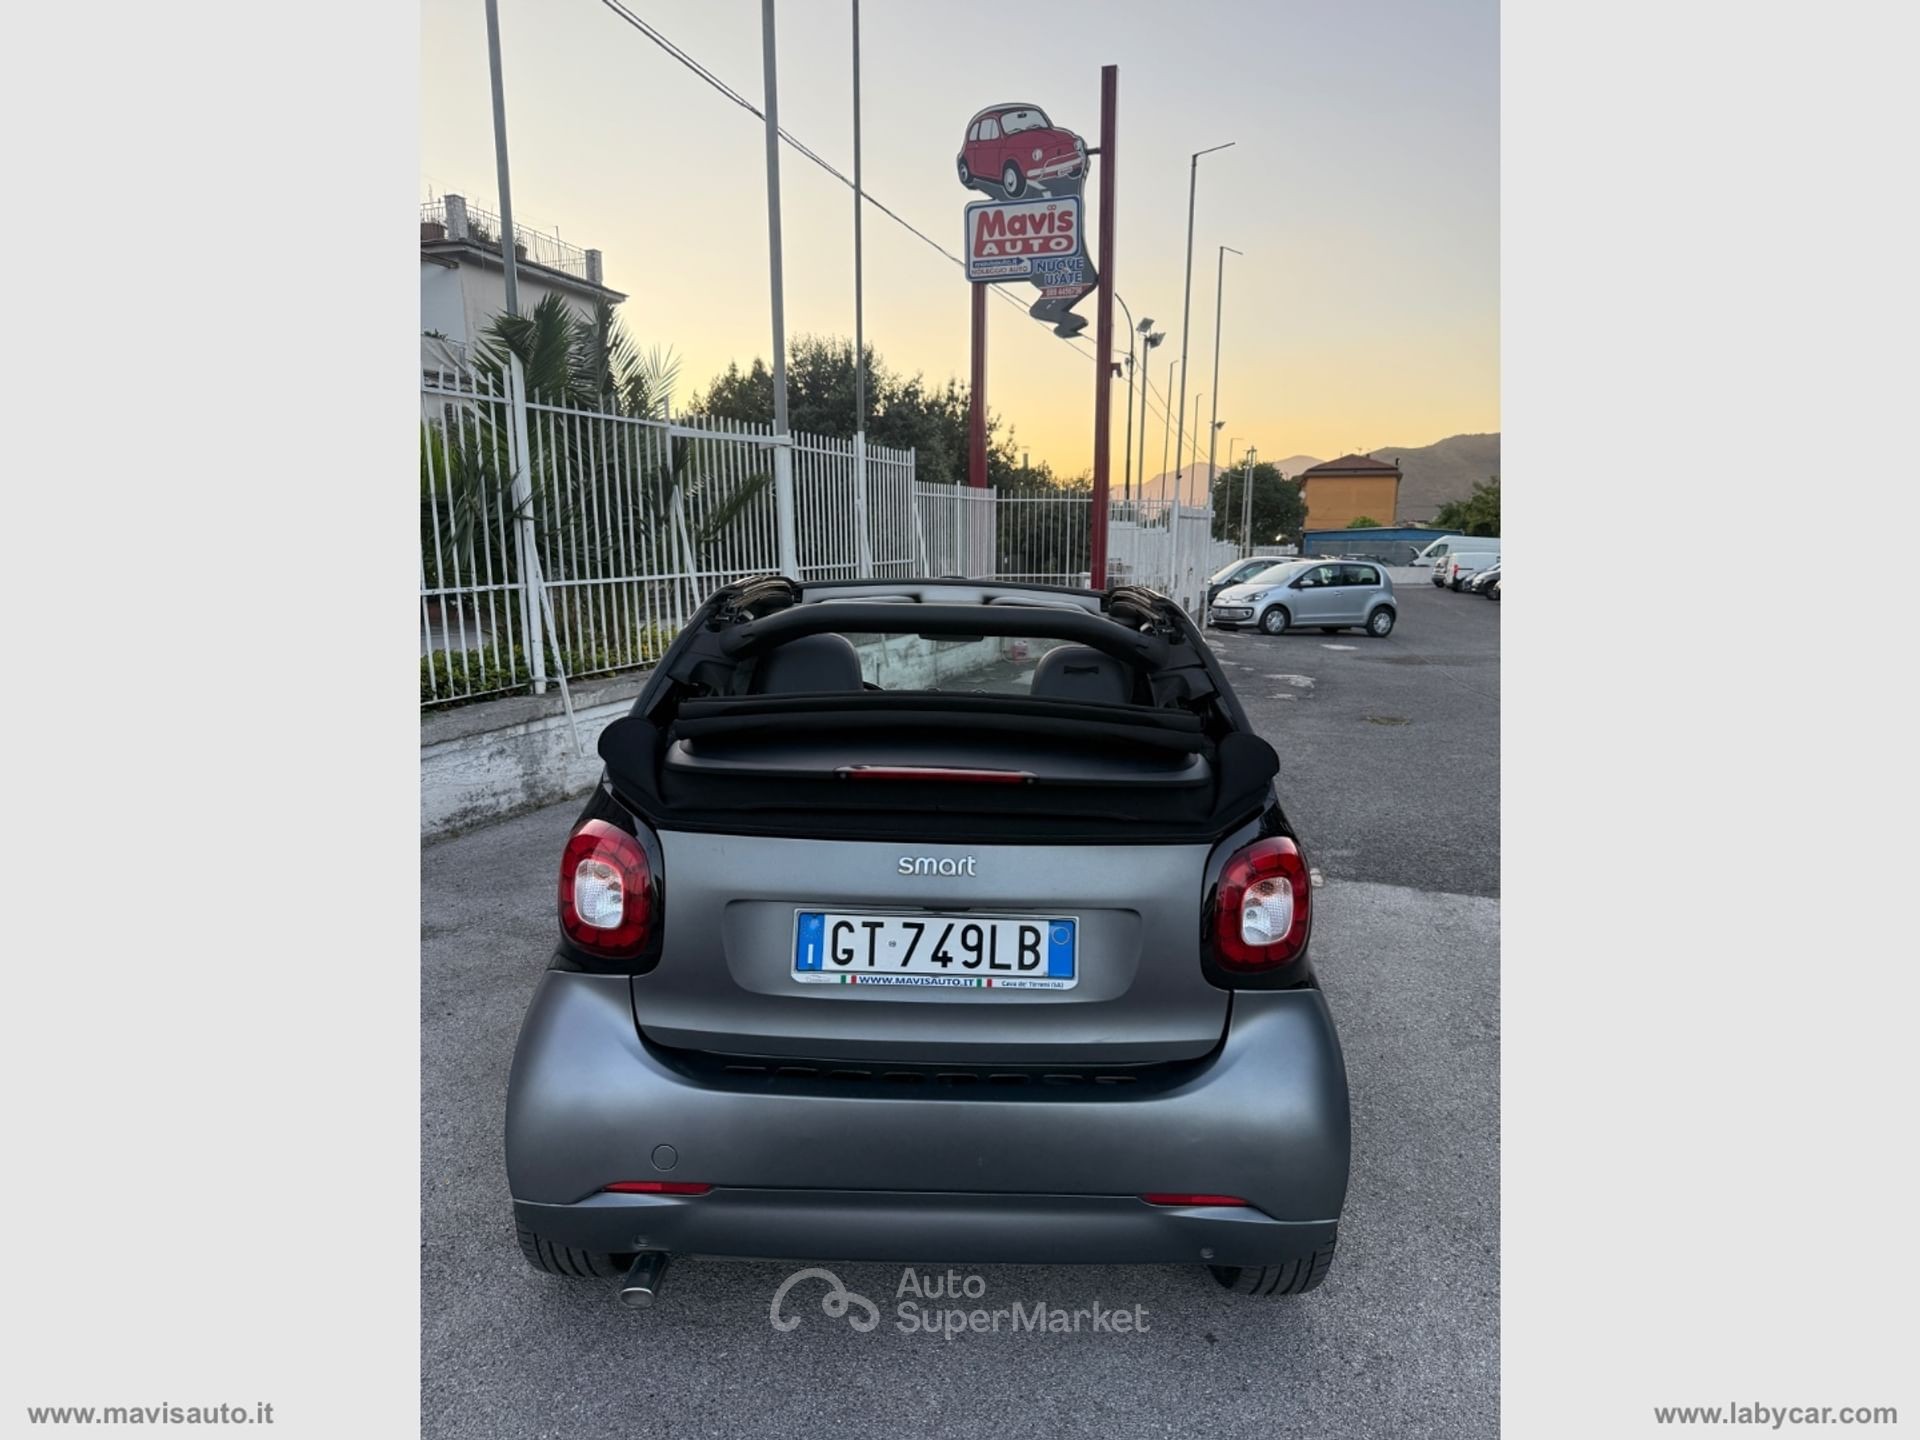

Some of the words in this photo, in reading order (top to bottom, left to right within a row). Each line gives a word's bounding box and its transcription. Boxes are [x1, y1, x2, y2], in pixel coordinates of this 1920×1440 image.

[976, 206, 1074, 239] Mavis
[982, 237, 1069, 256] AUTO
[1009, 265, 1028, 273] AUTO
[1037, 258, 1084, 272] NUOVE
[1045, 272, 1082, 286] USATE
[898, 855, 976, 876] smart
[859, 975, 975, 988] WWW.MAVISAUTO.IT
